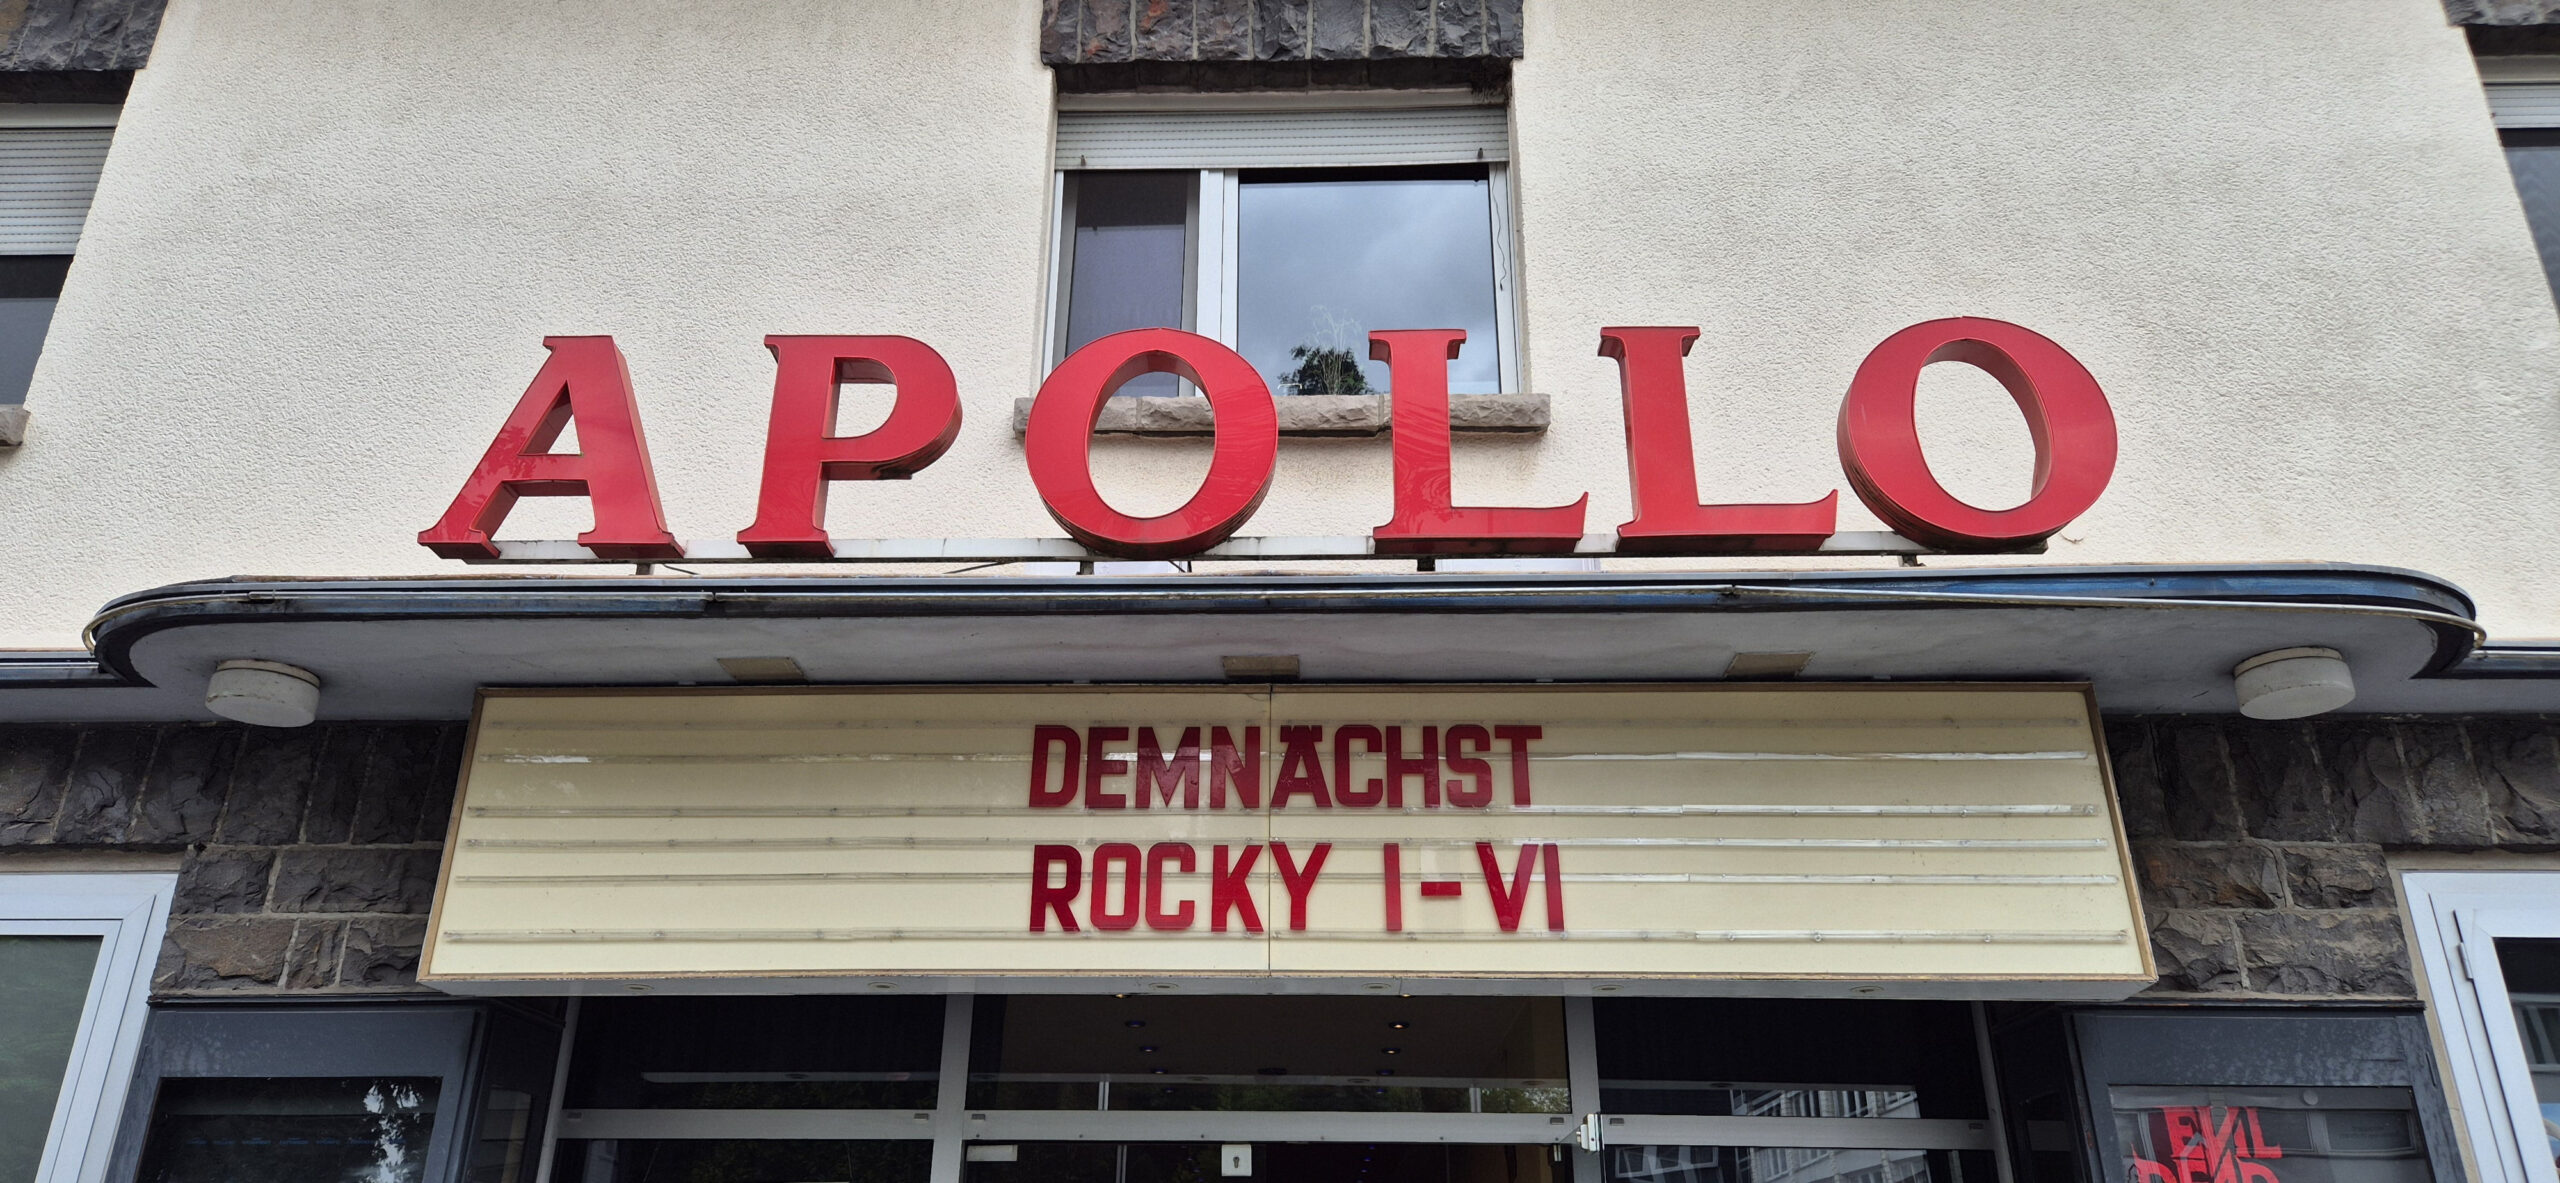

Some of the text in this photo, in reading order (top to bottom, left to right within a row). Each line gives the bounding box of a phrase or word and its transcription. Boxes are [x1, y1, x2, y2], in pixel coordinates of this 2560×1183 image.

[418, 316, 2118, 558] APOLLO
[1029, 724, 1542, 808] DEMNÄCHST
[1029, 842, 1565, 932] ROCKY I-VI
[2161, 1106, 2282, 1171] EVIL
